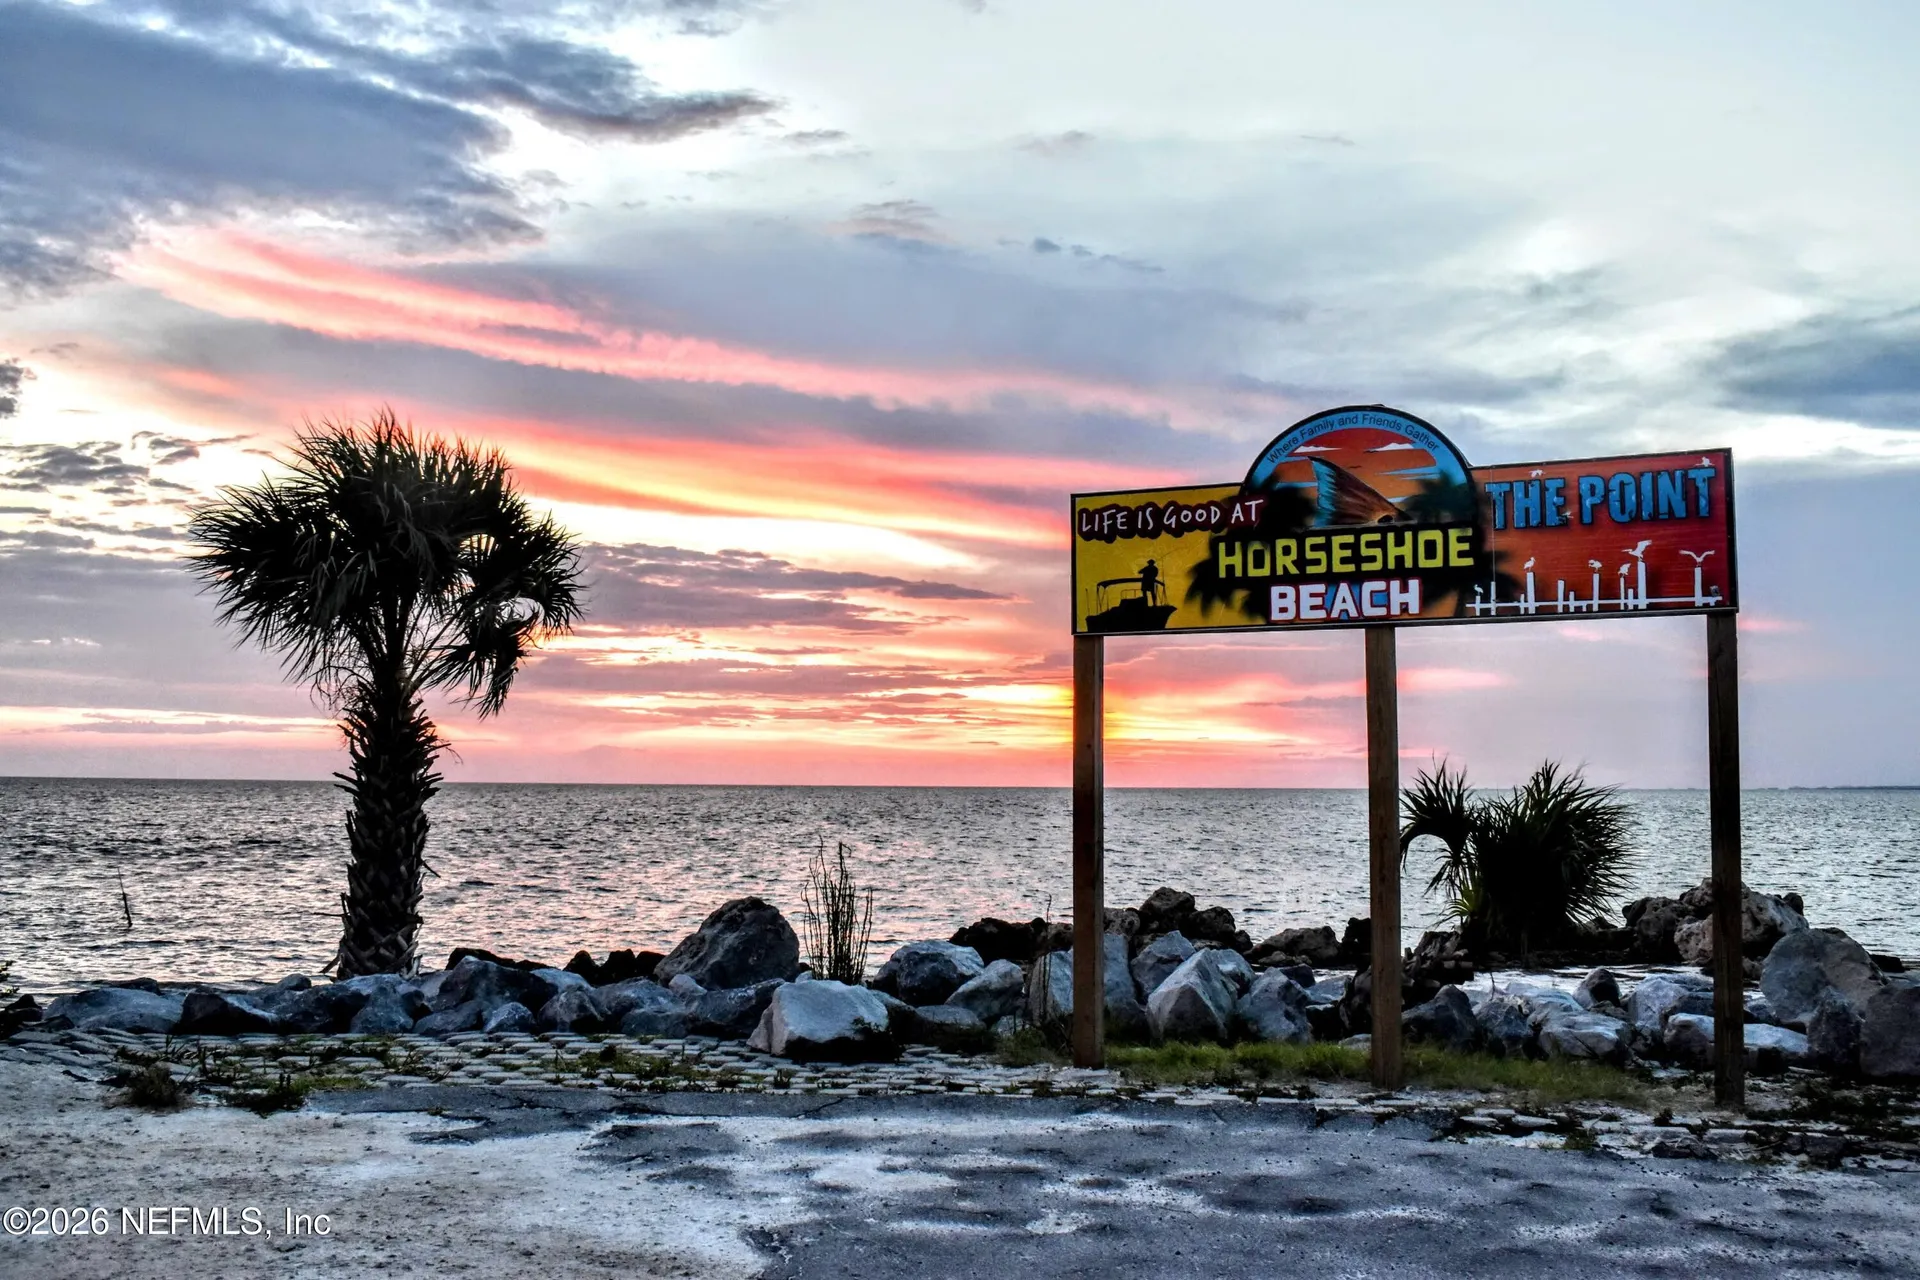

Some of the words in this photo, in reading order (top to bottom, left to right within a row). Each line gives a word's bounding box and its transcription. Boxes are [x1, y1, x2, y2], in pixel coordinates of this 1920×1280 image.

[1267, 435, 1300, 464] Where
[1300, 418, 1334, 440] Family
[1338, 415, 1358, 426] and
[1362, 414, 1402, 431] Friends
[1405, 424, 1440, 451] Gather
[1081, 507, 1127, 534] LIFE
[1137, 507, 1154, 529] IS
[1163, 503, 1221, 528] GOOD
[1231, 499, 1264, 523] AT
[1485, 477, 1566, 530] THE
[1578, 467, 1716, 525] POINT
[1218, 527, 1475, 579] HORSESHOE
[1270, 578, 1421, 622] BEACH
